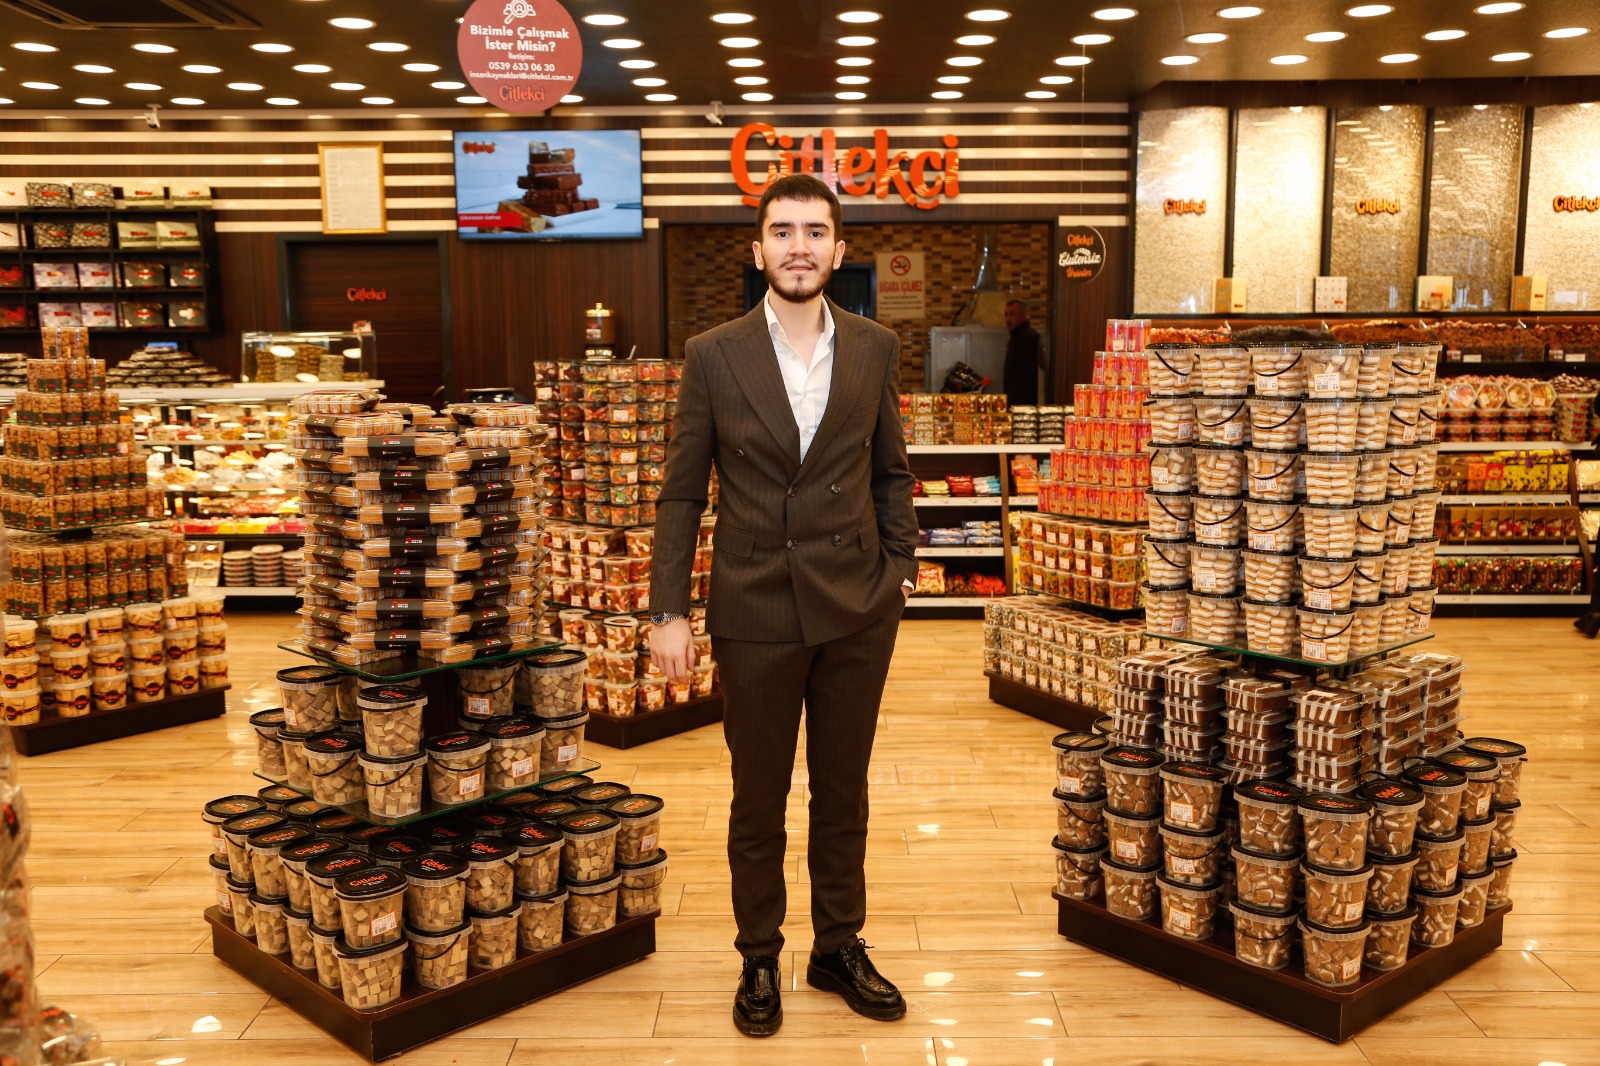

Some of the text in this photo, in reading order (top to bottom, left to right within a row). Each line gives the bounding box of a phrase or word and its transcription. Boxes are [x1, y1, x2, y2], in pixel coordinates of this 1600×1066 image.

[470, 25, 569, 40] Bizimle Çalışmak
[485, 37, 556, 52] İster Misin?
[488, 61, 555, 72] 0539 633 06 30
